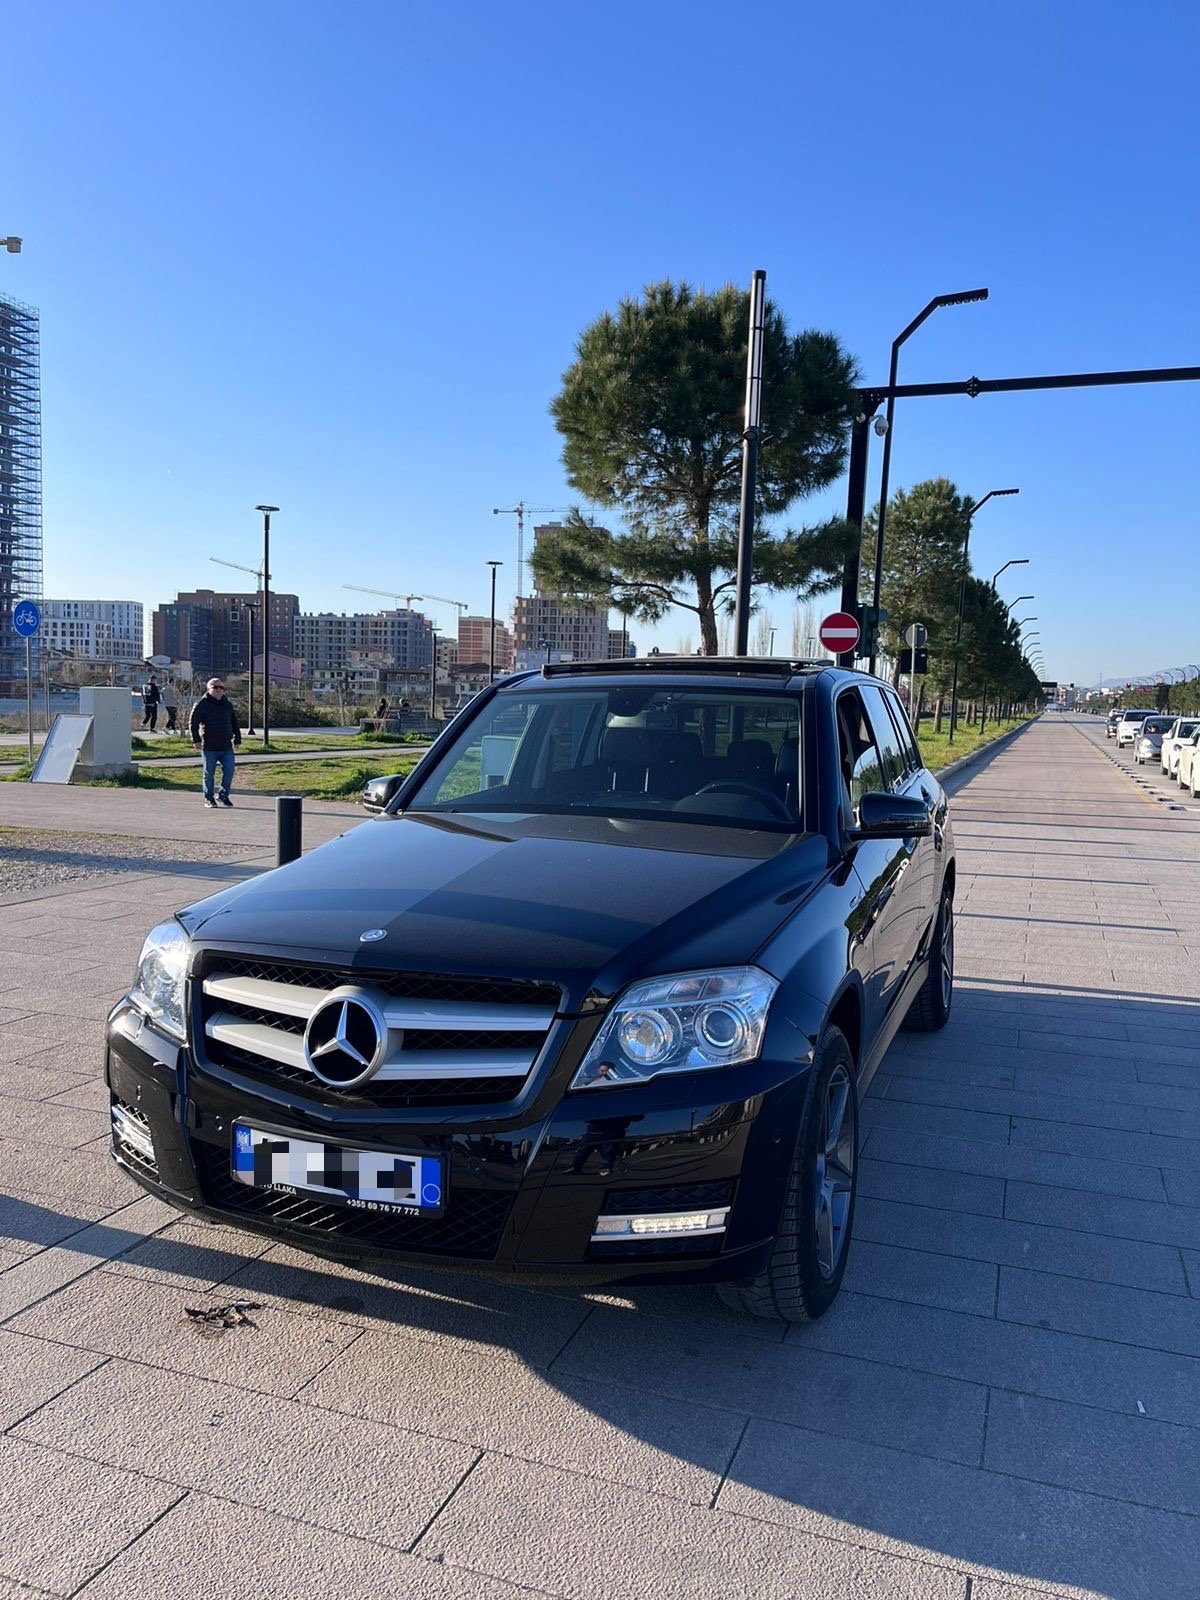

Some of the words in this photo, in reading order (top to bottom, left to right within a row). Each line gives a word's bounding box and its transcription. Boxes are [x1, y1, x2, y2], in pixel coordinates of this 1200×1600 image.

[273, 1184, 297, 1195] LLAKA
[346, 1199, 366, 1208] +355
[379, 1204, 390, 1212] 76
[391, 1205, 402, 1213] 77
[404, 1207, 420, 1216] 772
